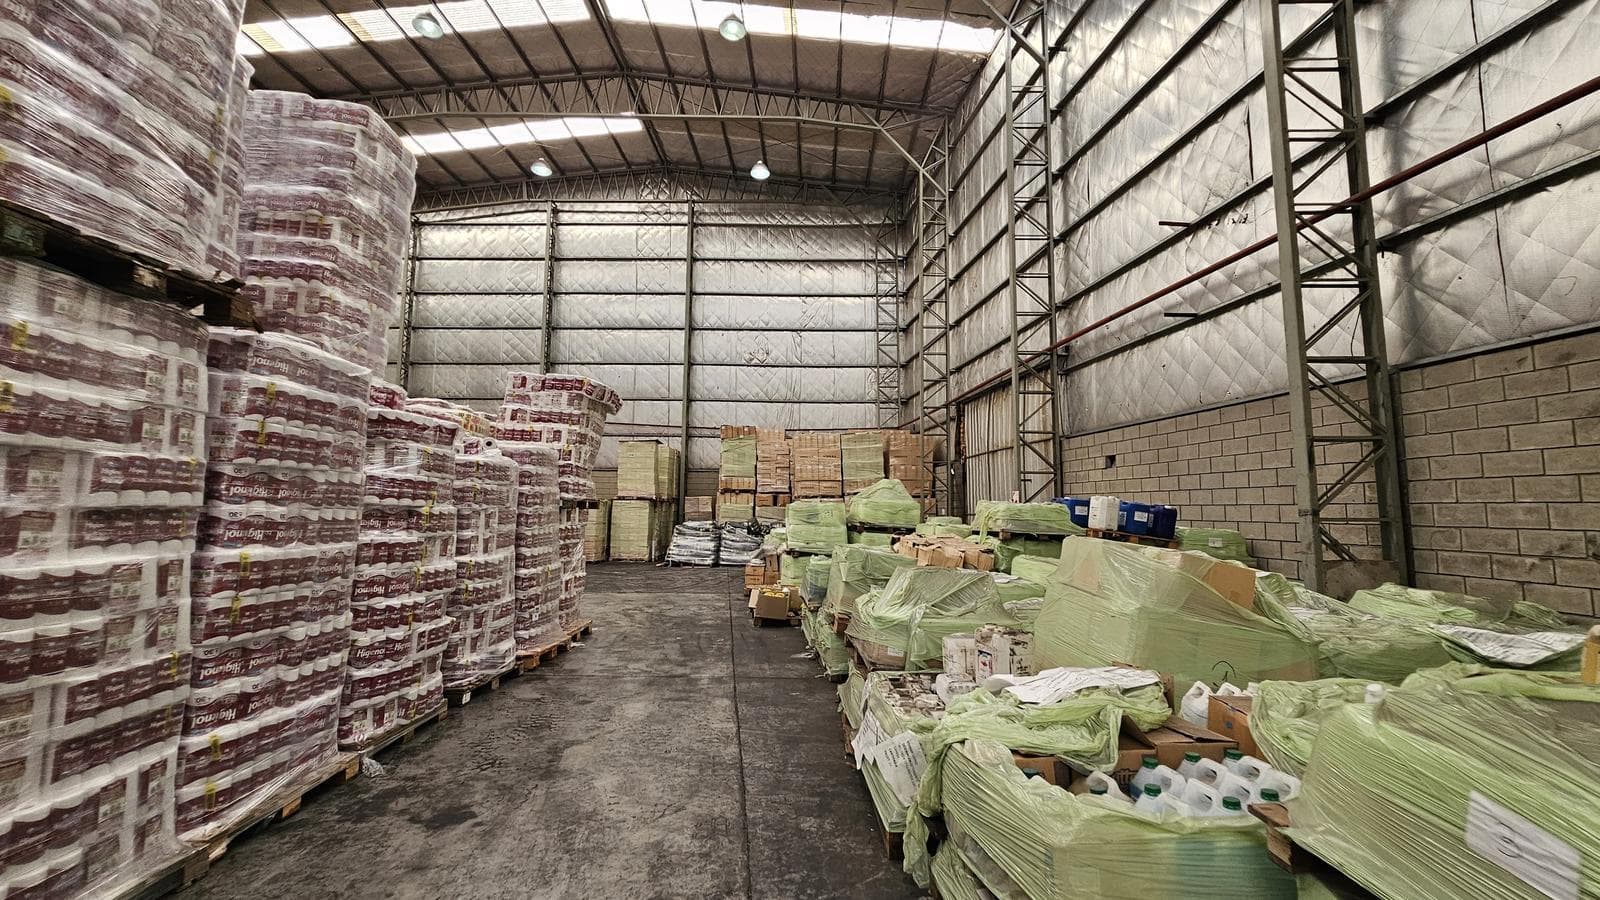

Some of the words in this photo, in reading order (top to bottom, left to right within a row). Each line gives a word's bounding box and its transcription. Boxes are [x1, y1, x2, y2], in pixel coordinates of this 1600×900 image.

[223, 528, 264, 541] Higienol
[199, 662, 242, 680] Higienol
[190, 707, 237, 729] Higienol
